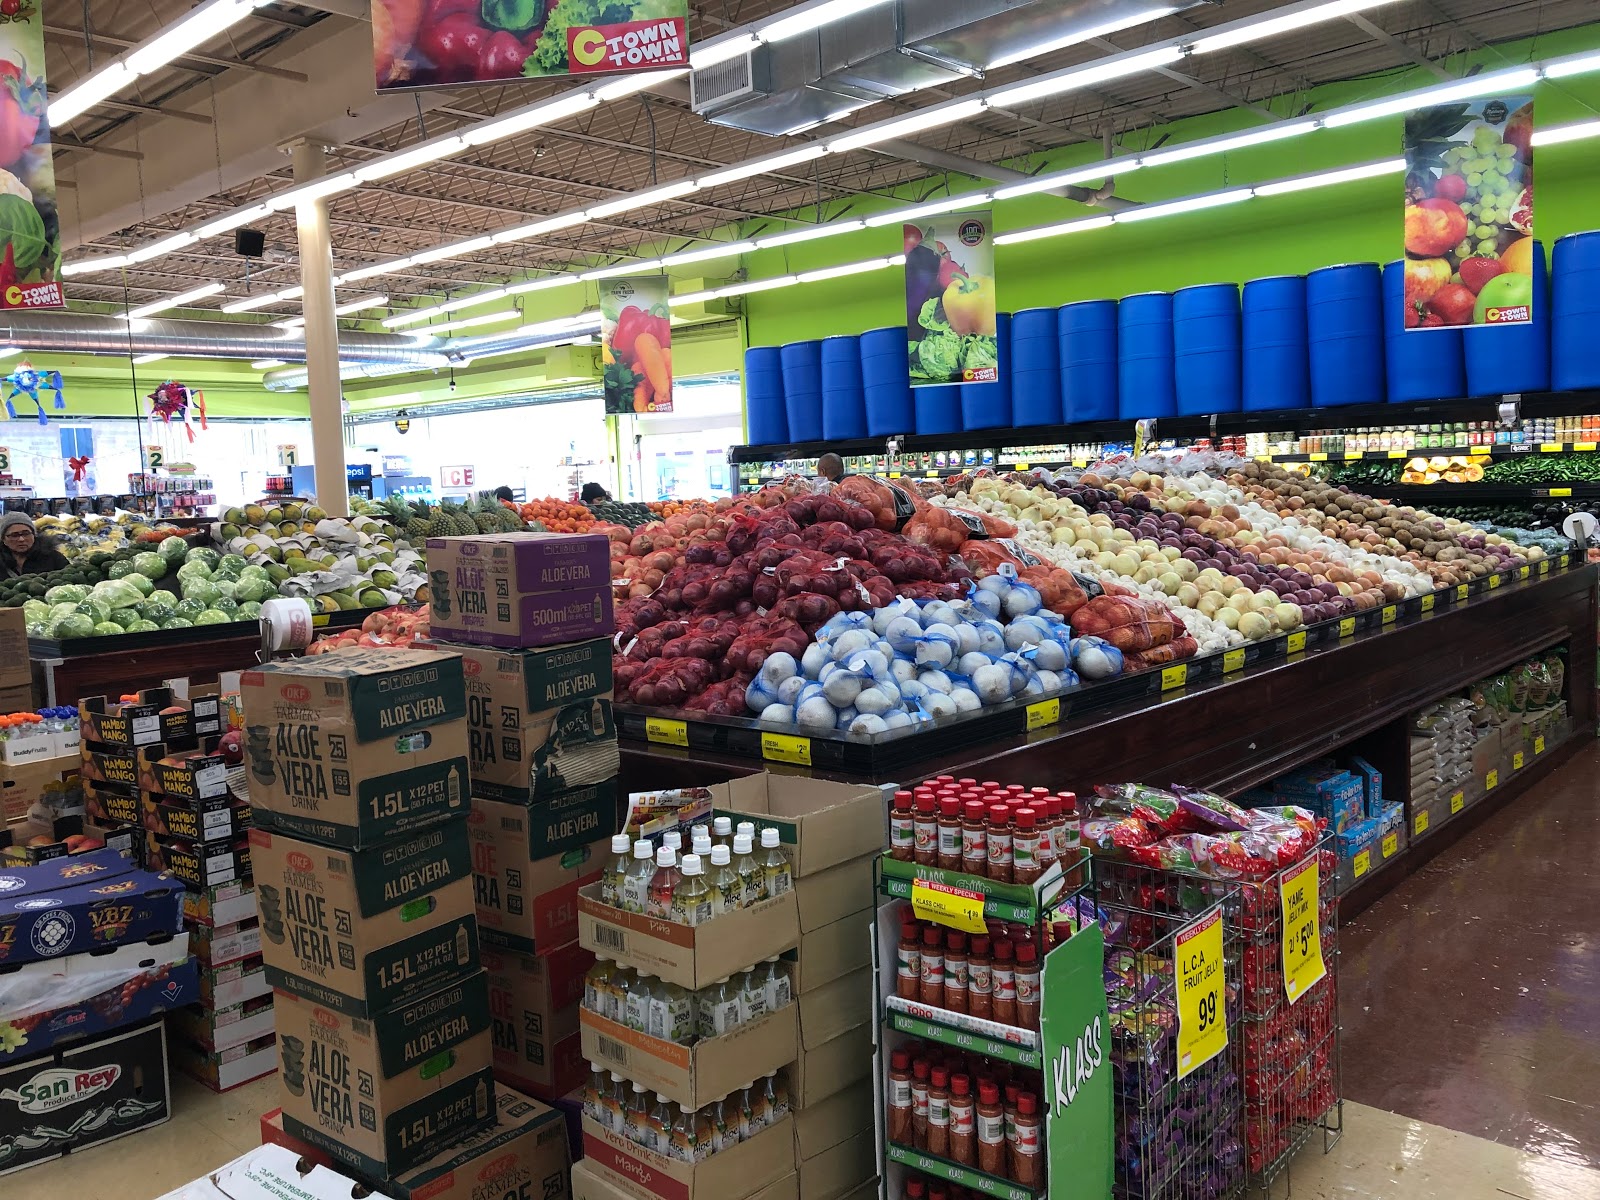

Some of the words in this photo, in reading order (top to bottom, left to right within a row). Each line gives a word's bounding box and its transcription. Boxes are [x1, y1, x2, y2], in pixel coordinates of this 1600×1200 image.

[606, 20, 677, 53] TOWN
[609, 37, 682, 66] TOWN
[22, 283, 58, 299] TOWN
[24, 291, 60, 306] TOWN
[1500, 306, 1526, 317] TOWN
[1501, 312, 1528, 321] TOWN
[151, 452, 162, 466] 2
[287, 452, 295, 464] 1
[346, 468, 364, 477] epsi
[456, 567, 486, 590] ALOE
[455, 589, 487, 614] VERA
[533, 606, 567, 626] 500ml
[287, 688, 305, 699] OKF
[465, 682, 491, 694] MER'S
[468, 696, 493, 729] OE
[101, 719, 126, 730] MAMBO
[502, 713, 516, 728] 25
[102, 730, 127, 742] MANGO
[276, 722, 322, 761] ALOE
[329, 741, 344, 758] 25
[470, 730, 496, 764] RA
[104, 759, 132, 769] MAMBO
[105, 770, 135, 781] MANGO
[163, 770, 191, 782] MAMBO
[275, 757, 329, 800] VERA
[333, 775, 348, 786] 155
[164, 782, 193, 795] MANGO
[107, 799, 136, 809] MAMBO
[292, 796, 320, 811] DRINK
[370, 790, 410, 819] 1.5L
[108, 808, 138, 822] MANGO
[168, 812, 196, 824] MAMBO
[169, 824, 198, 837] MANGO
[171, 855, 198, 869] MAMBO
[291, 855, 308, 868] OKF
[473, 843, 498, 876] OE
[172, 868, 200, 882] MANGO
[1284, 868, 1301, 882] WEEKLY
[1301, 857, 1317, 873] SPECIAL
[507, 874, 519, 887] 25
[745, 881, 762, 894] Aloe
[892, 883, 907, 892] KLASS
[476, 875, 501, 909] RA
[931, 883, 953, 893] WEEKLY
[954, 888, 977, 899] SPECIAL
[1288, 887, 1304, 910] YAME
[724, 892, 741, 907] Aloe
[916, 898, 932, 907] KLASS
[933, 902, 946, 910] CHILI
[985, 902, 997, 912] LASS
[88, 905, 134, 927] VBZ
[285, 887, 329, 932] ALOE
[671, 903, 686, 916] Aloe
[1013, 908, 1030, 919] KLASS
[335, 915, 349, 933] 25
[1180, 925, 1201, 943] WEEKLY
[1202, 913, 1219, 930] SPECIAL
[35, 938, 71, 956] CALIFORNIA
[285, 918, 335, 970] VERA
[301, 959, 327, 979] DRINK
[1183, 950, 1205, 976] L.C.A
[377, 957, 417, 989] 1.5L
[1184, 970, 1203, 992] FRUIT
[1204, 958, 1219, 979] JELLY
[317, 1011, 337, 1028] OKF
[899, 1019, 913, 1028] KLASS
[493, 1019, 518, 1052] RA
[928, 1026, 942, 1037] KLASS
[957, 1034, 973, 1045] KLASS
[987, 1043, 1003, 1054] KLASS
[309, 1041, 351, 1088] ALOE
[1019, 1052, 1035, 1063] KLASS
[1053, 1015, 1102, 1118] KLASS
[19, 1075, 69, 1105] San
[74, 1066, 118, 1093] Rey
[358, 1075, 372, 1095] 25
[43, 1093, 76, 1108] Produce
[307, 1072, 354, 1129] VERA
[360, 1108, 375, 1123] 155
[318, 1114, 346, 1137] DRINK
[398, 1116, 437, 1149] 1.5L
[722, 1127, 738, 1139] Aloe
[603, 1127, 625, 1147] Vera
[627, 1142, 652, 1162] Drink
[693, 1141, 711, 1154] Aloe
[891, 1148, 905, 1158] KLASS
[615, 1155, 652, 1183] Mango
[919, 1158, 934, 1168] KLASS
[948, 1168, 964, 1179] KLASS
[978, 1179, 994, 1190] KLASS
